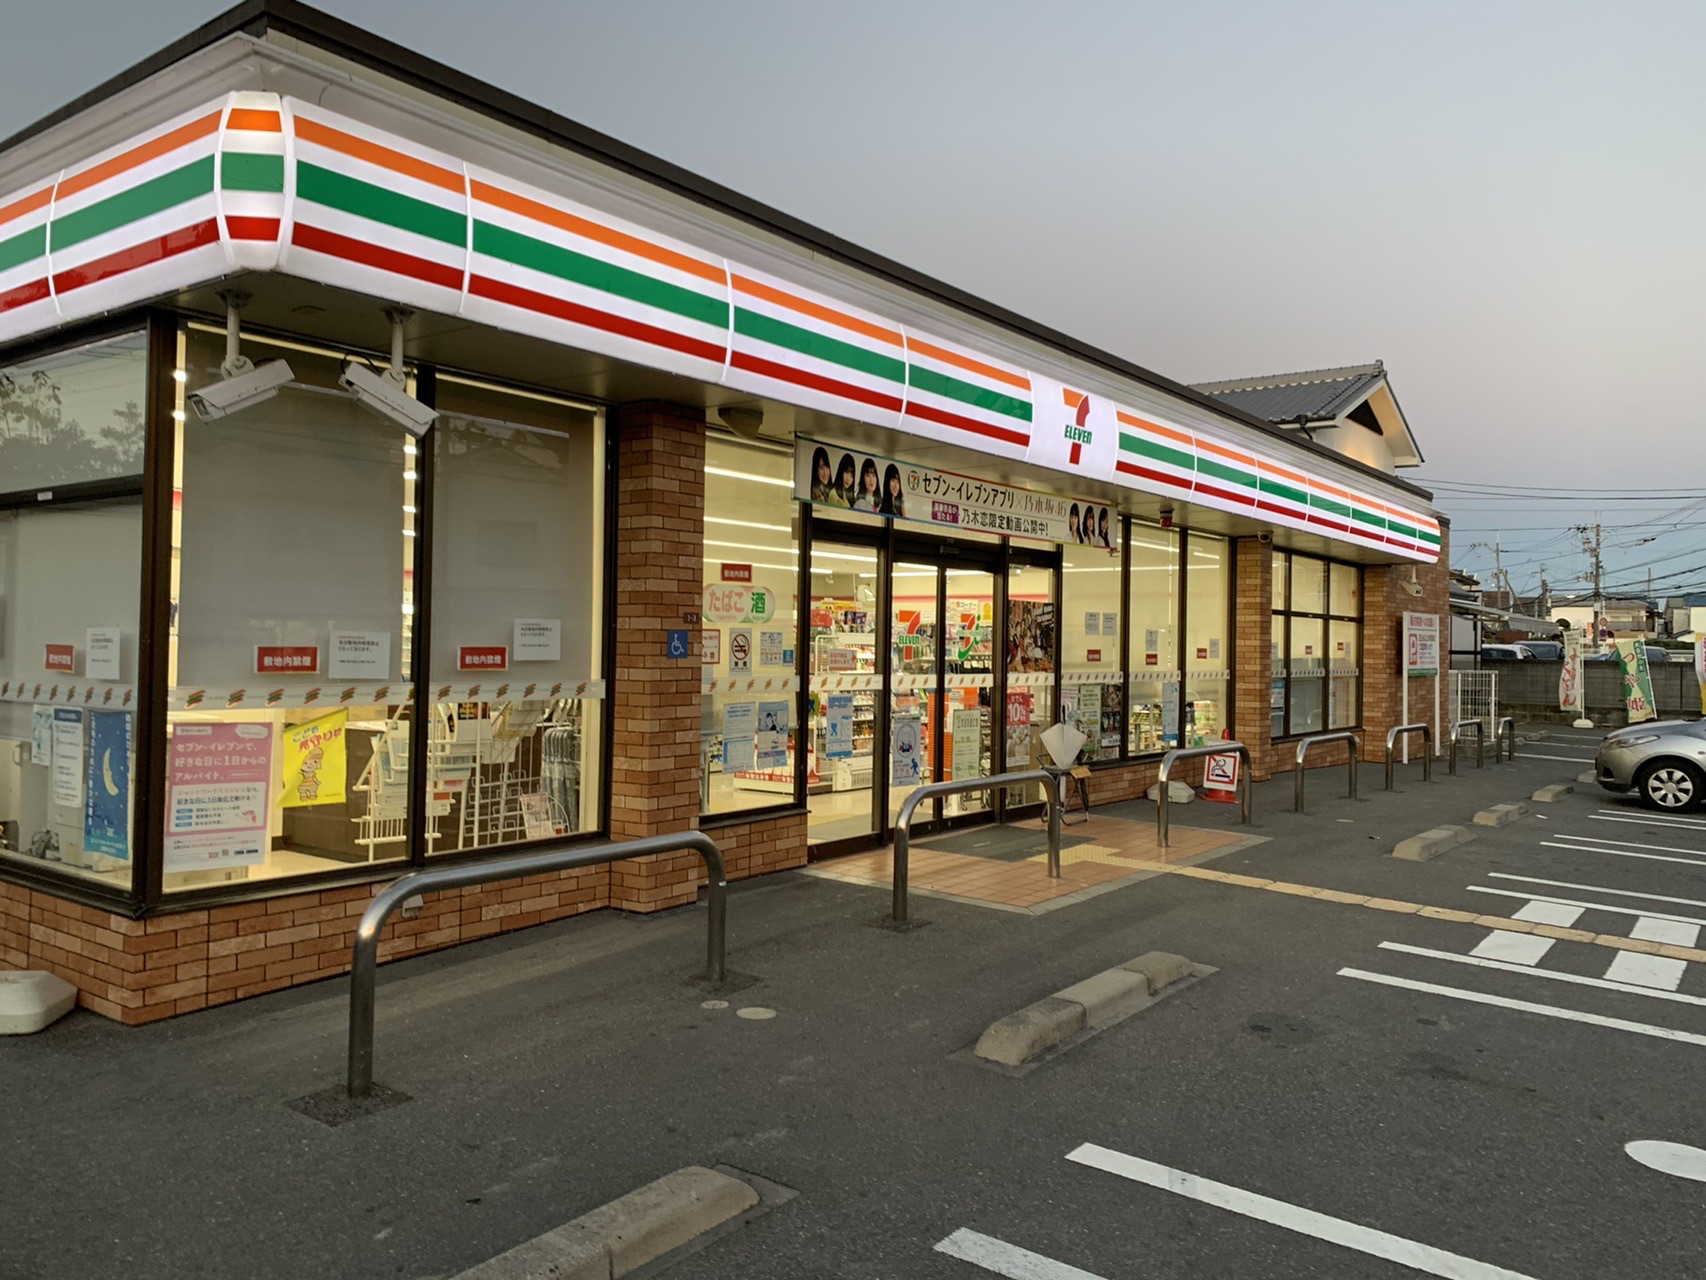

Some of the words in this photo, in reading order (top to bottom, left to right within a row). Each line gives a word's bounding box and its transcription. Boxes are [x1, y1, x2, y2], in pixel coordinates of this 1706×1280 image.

[709, 589, 745, 613] たばこ
[751, 592, 766, 614] 酒
[263, 656, 311, 667] 敷地内禁煙
[465, 655, 502, 665] 敷地内禁煙
[175, 755, 267, 768] 好きな日に1日からの
